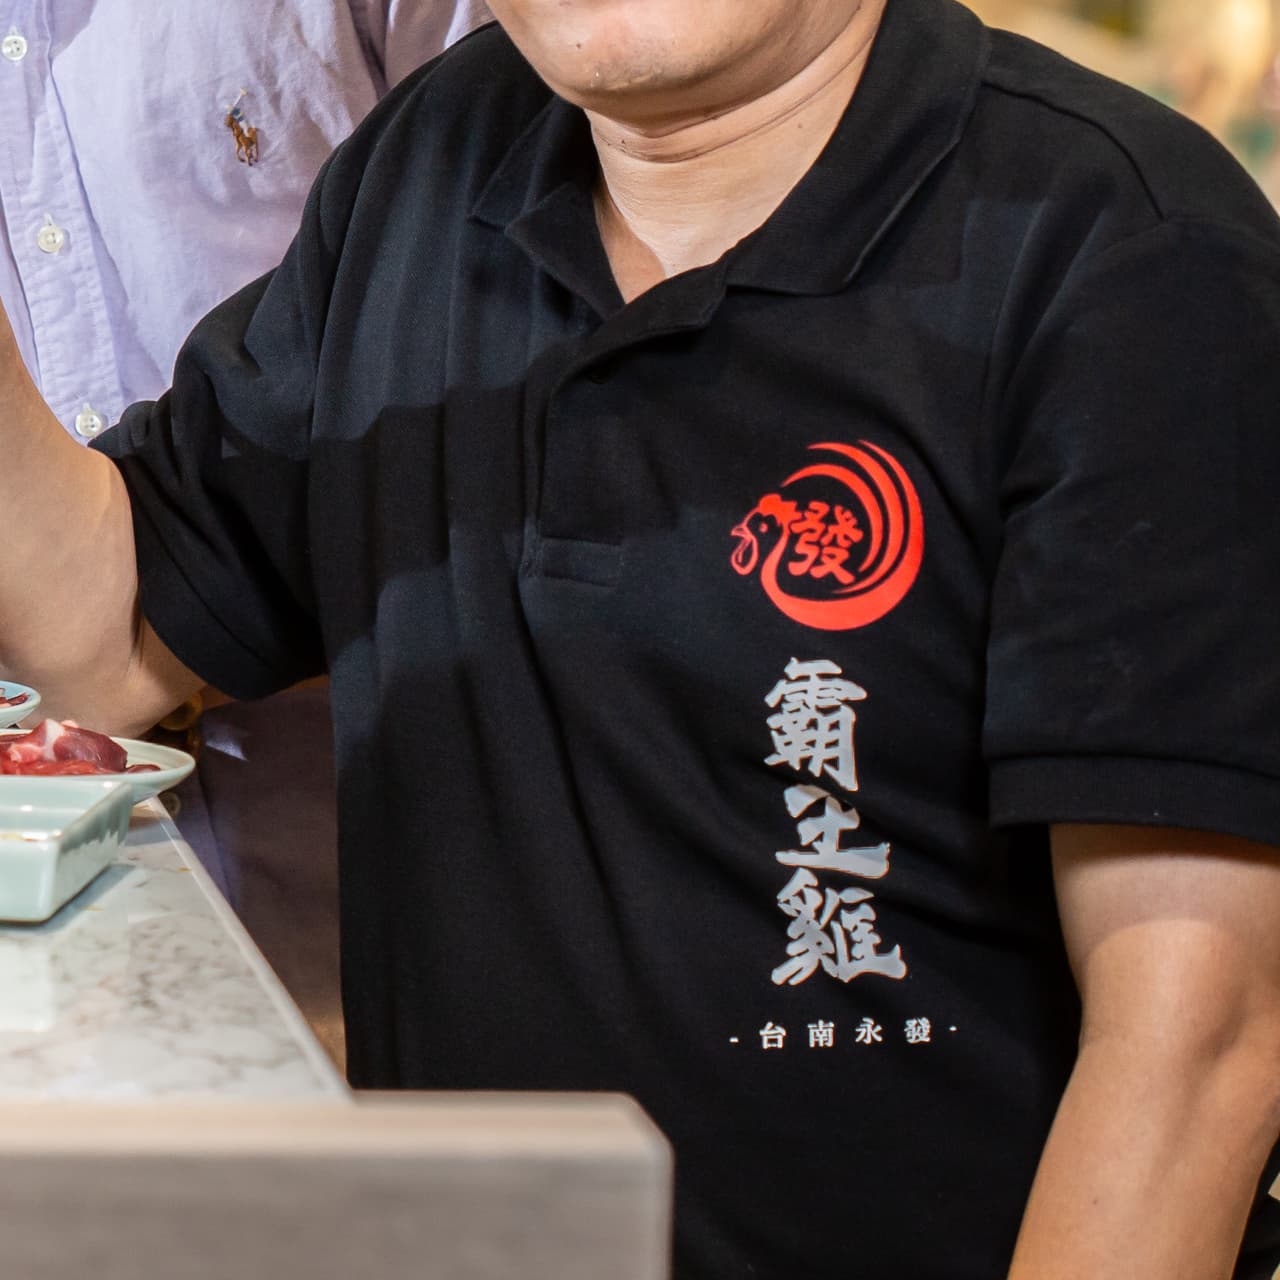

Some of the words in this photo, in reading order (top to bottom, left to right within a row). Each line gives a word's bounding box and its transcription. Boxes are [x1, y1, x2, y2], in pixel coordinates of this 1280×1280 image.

[788, 500, 864, 586] 發
[763, 656, 907, 986] 霸王雞
